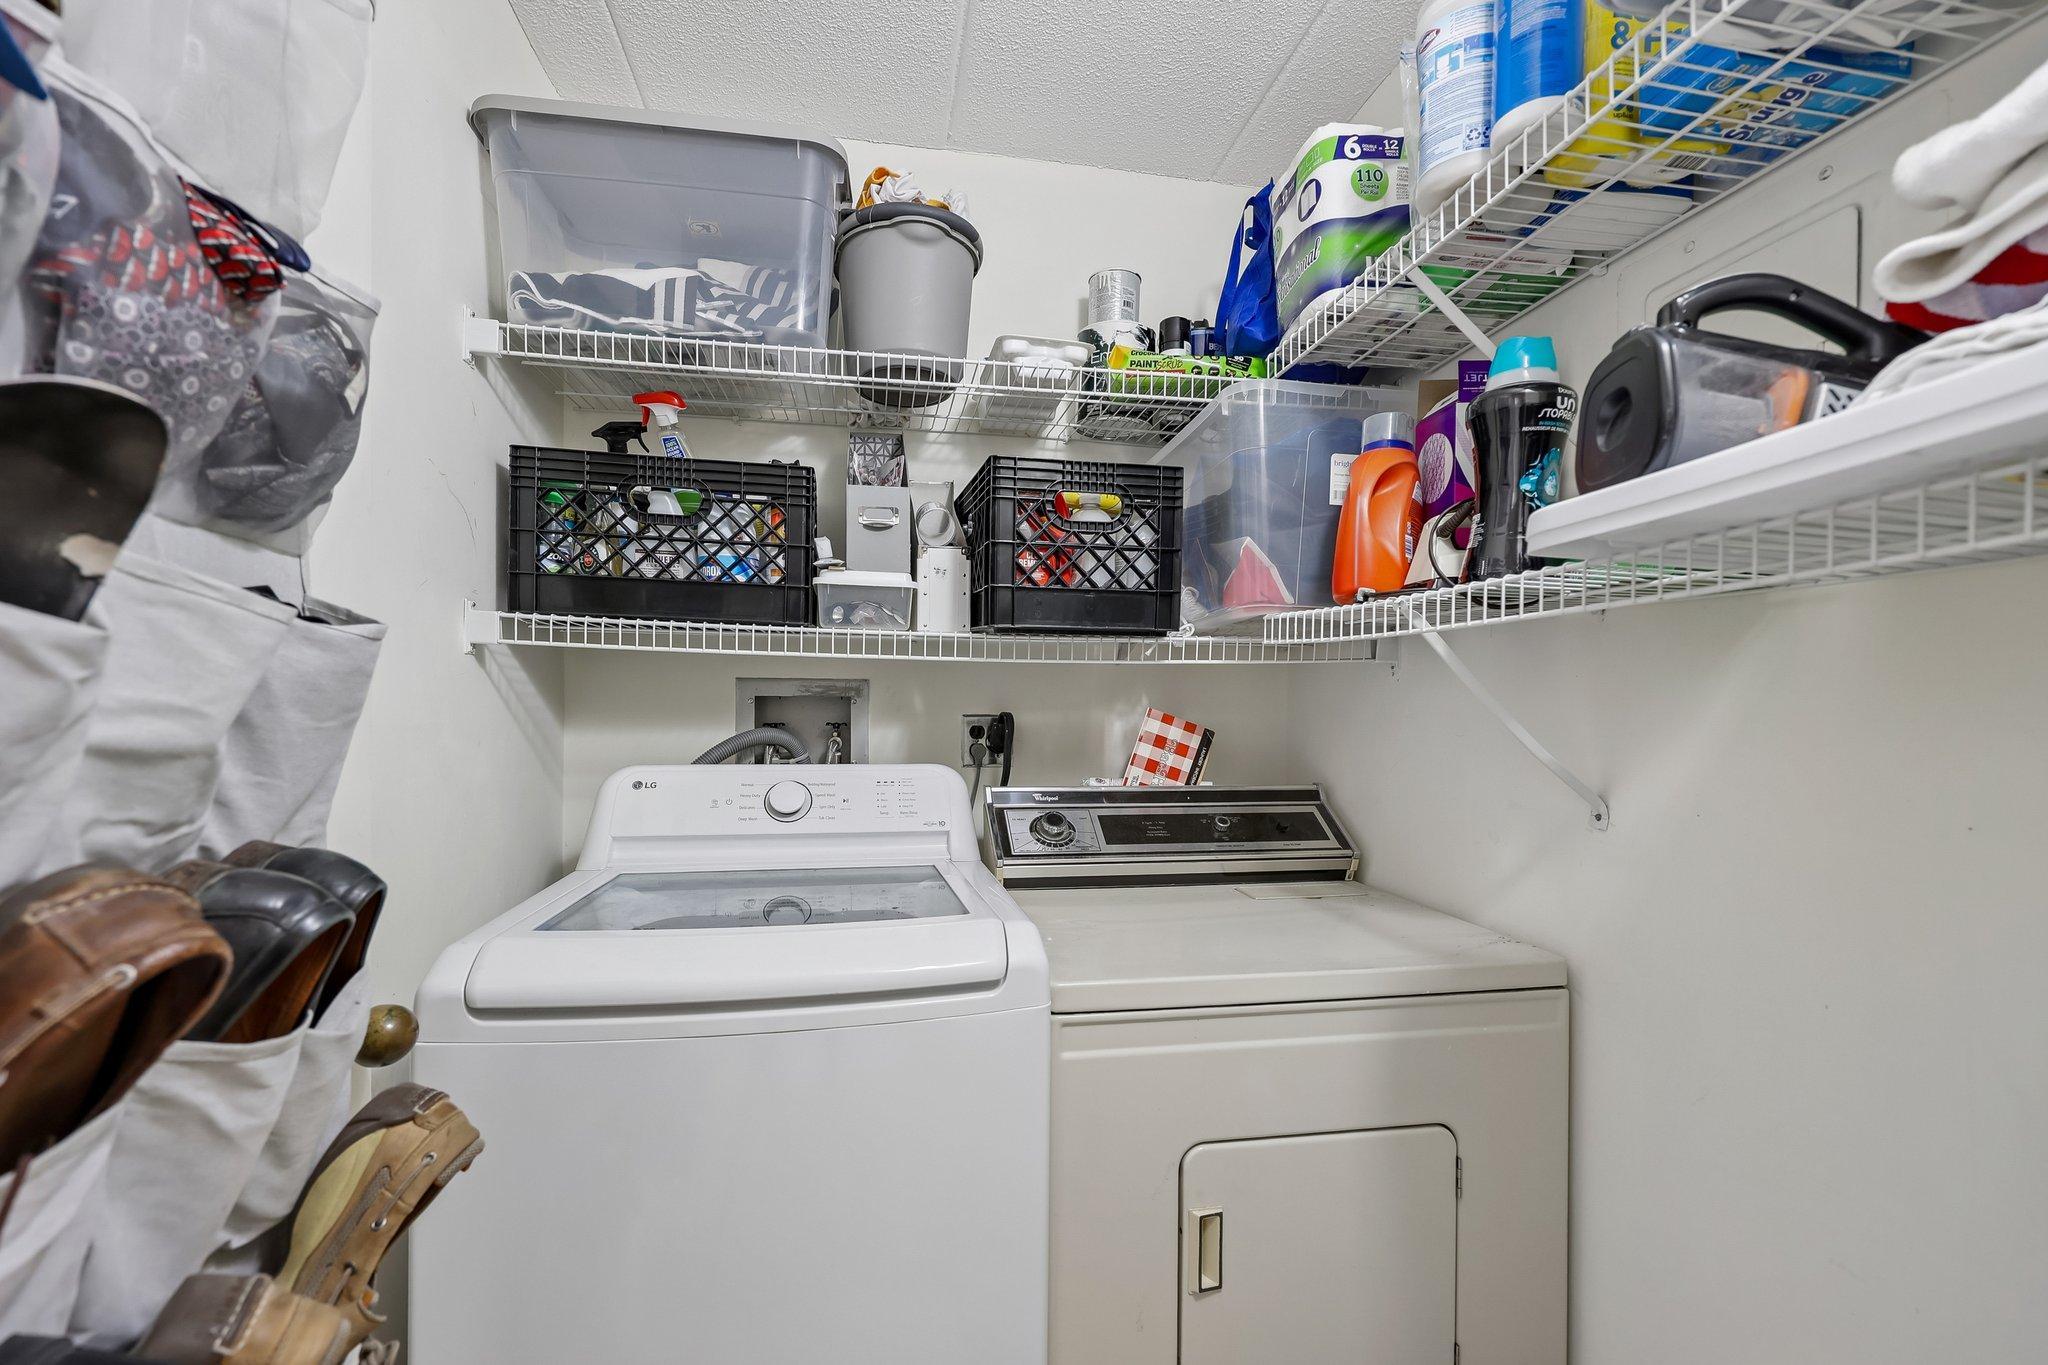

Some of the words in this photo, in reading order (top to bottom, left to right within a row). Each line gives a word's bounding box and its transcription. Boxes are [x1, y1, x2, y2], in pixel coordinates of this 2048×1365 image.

[1343, 135, 1362, 159] 6
[1382, 139, 1400, 151] 12
[1356, 169, 1384, 182] 110
[1129, 360, 1158, 368] PAINT
[644, 781, 657, 789] LG
[1033, 793, 1059, 802] Whirlpool
